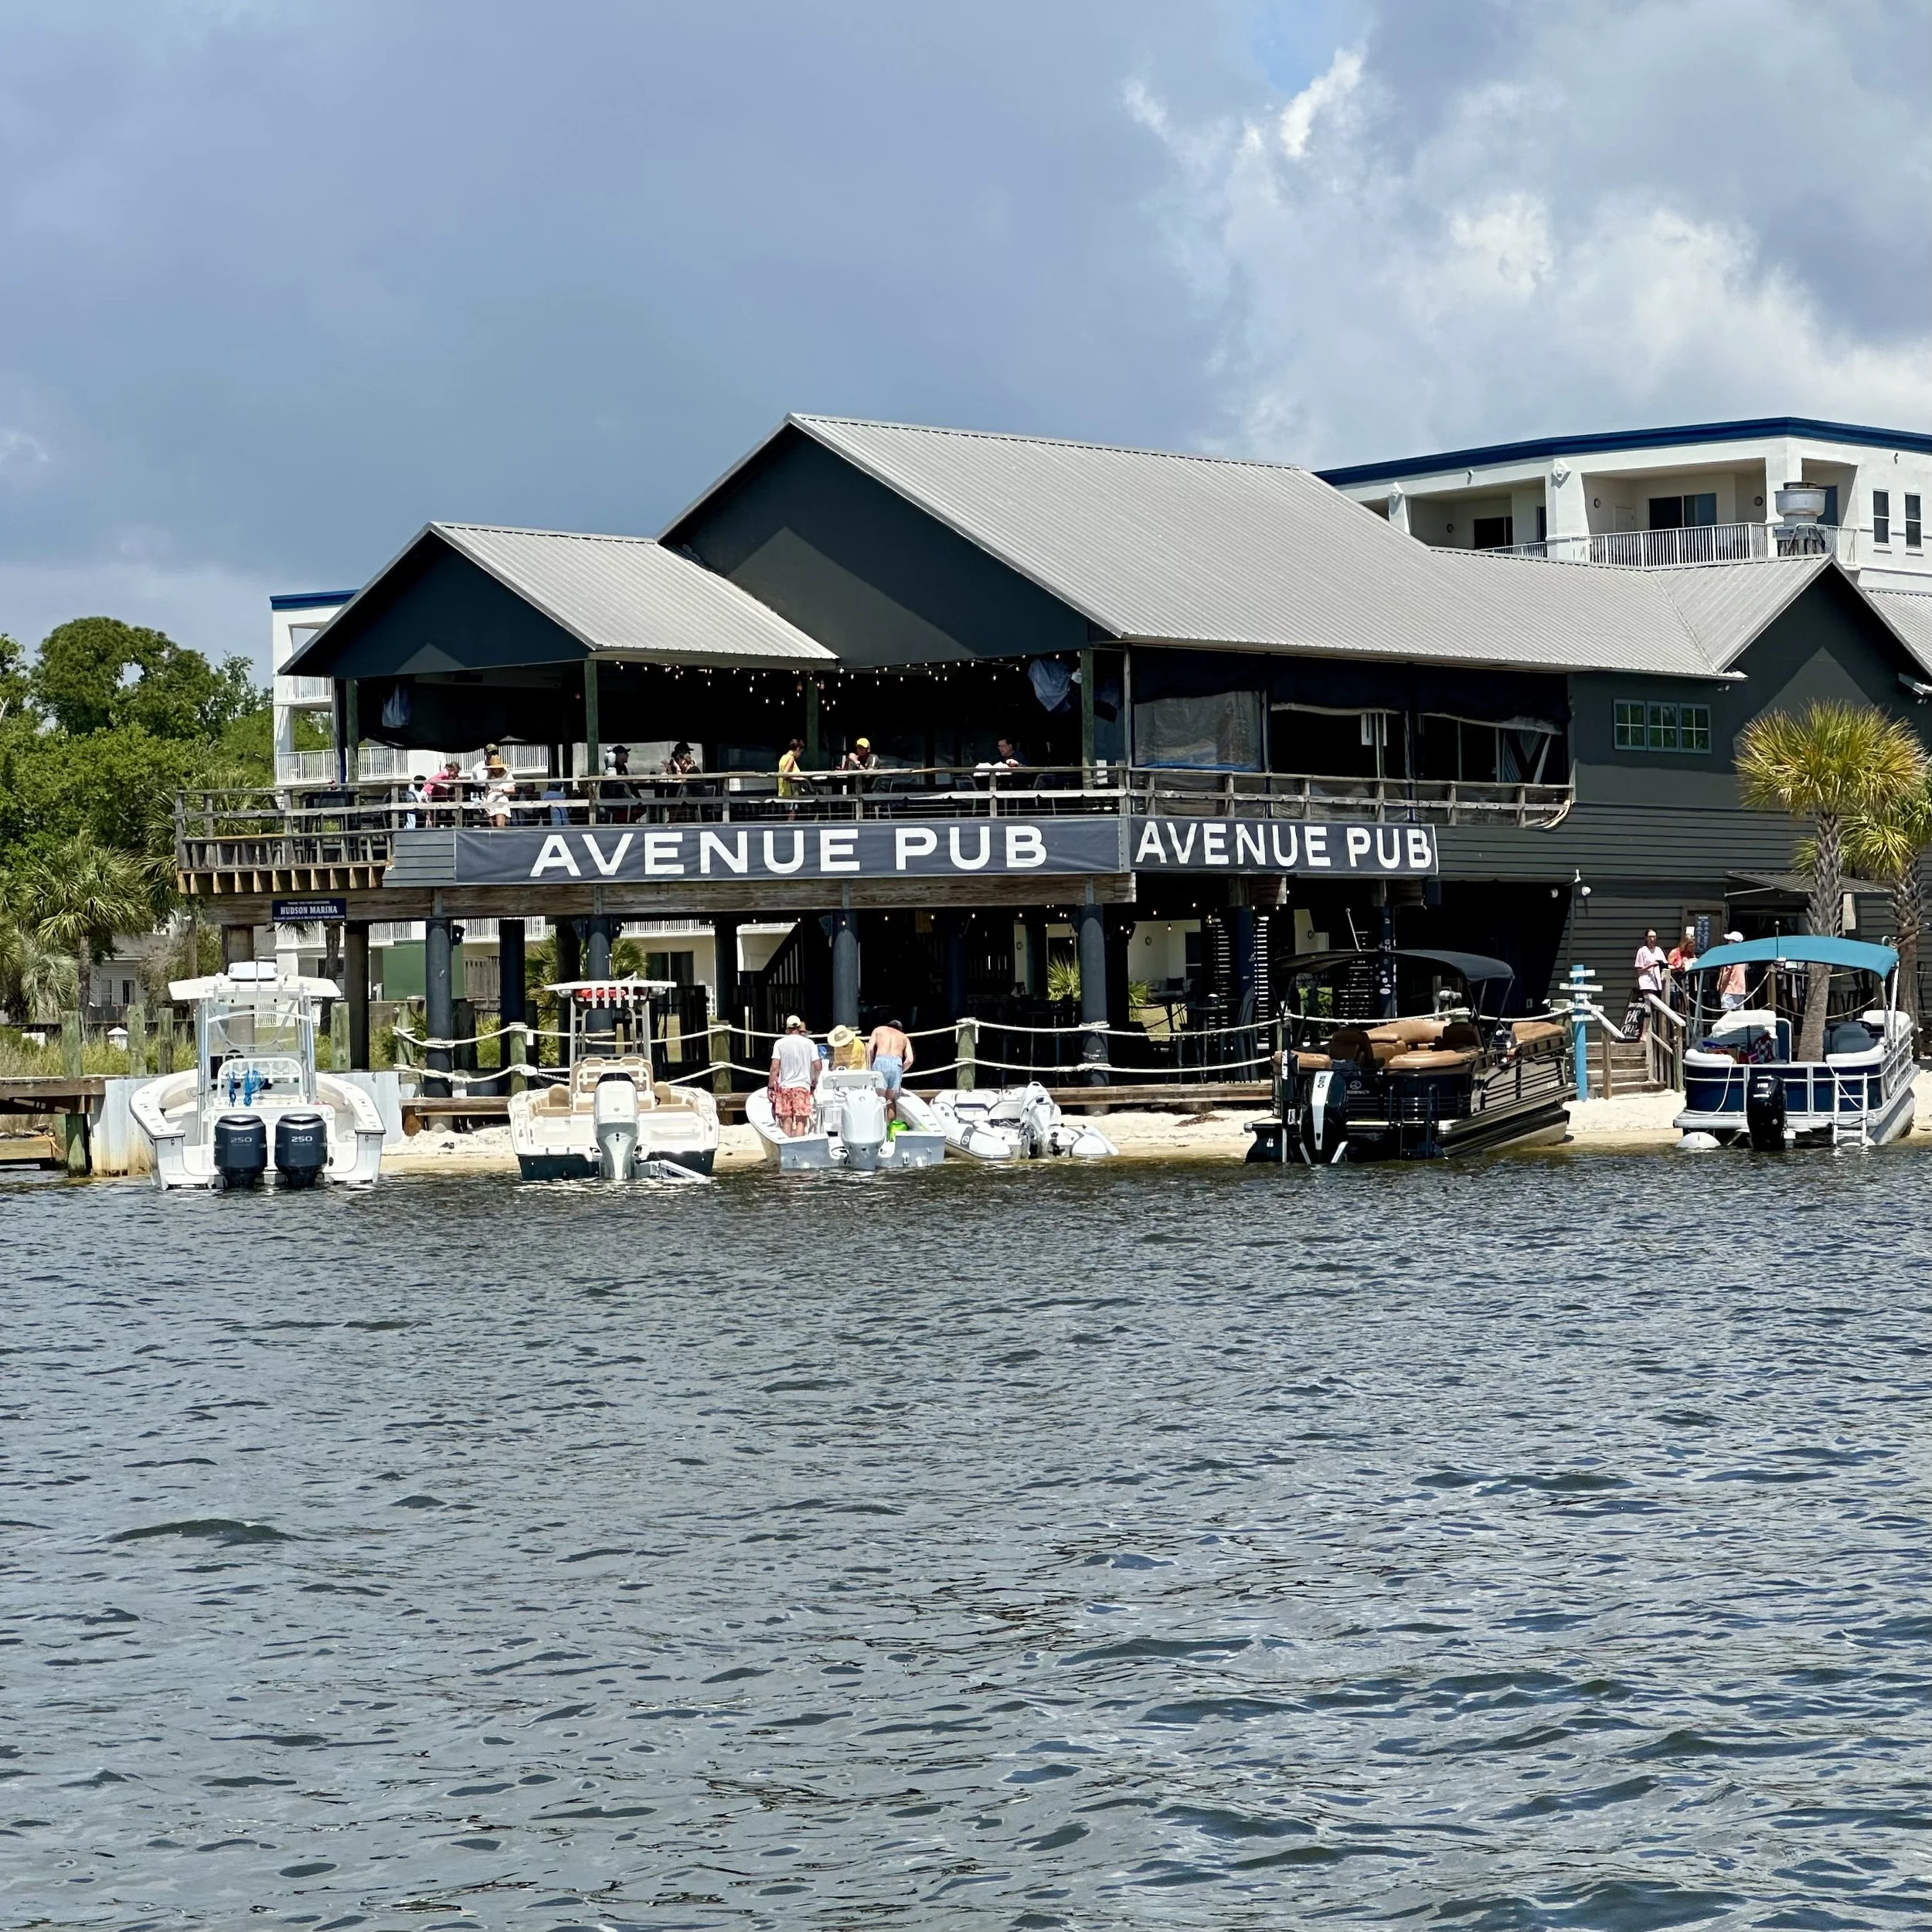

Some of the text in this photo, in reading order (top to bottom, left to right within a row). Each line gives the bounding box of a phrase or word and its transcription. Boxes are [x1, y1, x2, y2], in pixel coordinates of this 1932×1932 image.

[529, 825, 1047, 878] AVENUE PUB
[1135, 821, 1432, 869] AVENUE PUB
[281, 906, 338, 915] HUDSON MARINA
[1624, 1010, 1641, 1024] BAR
